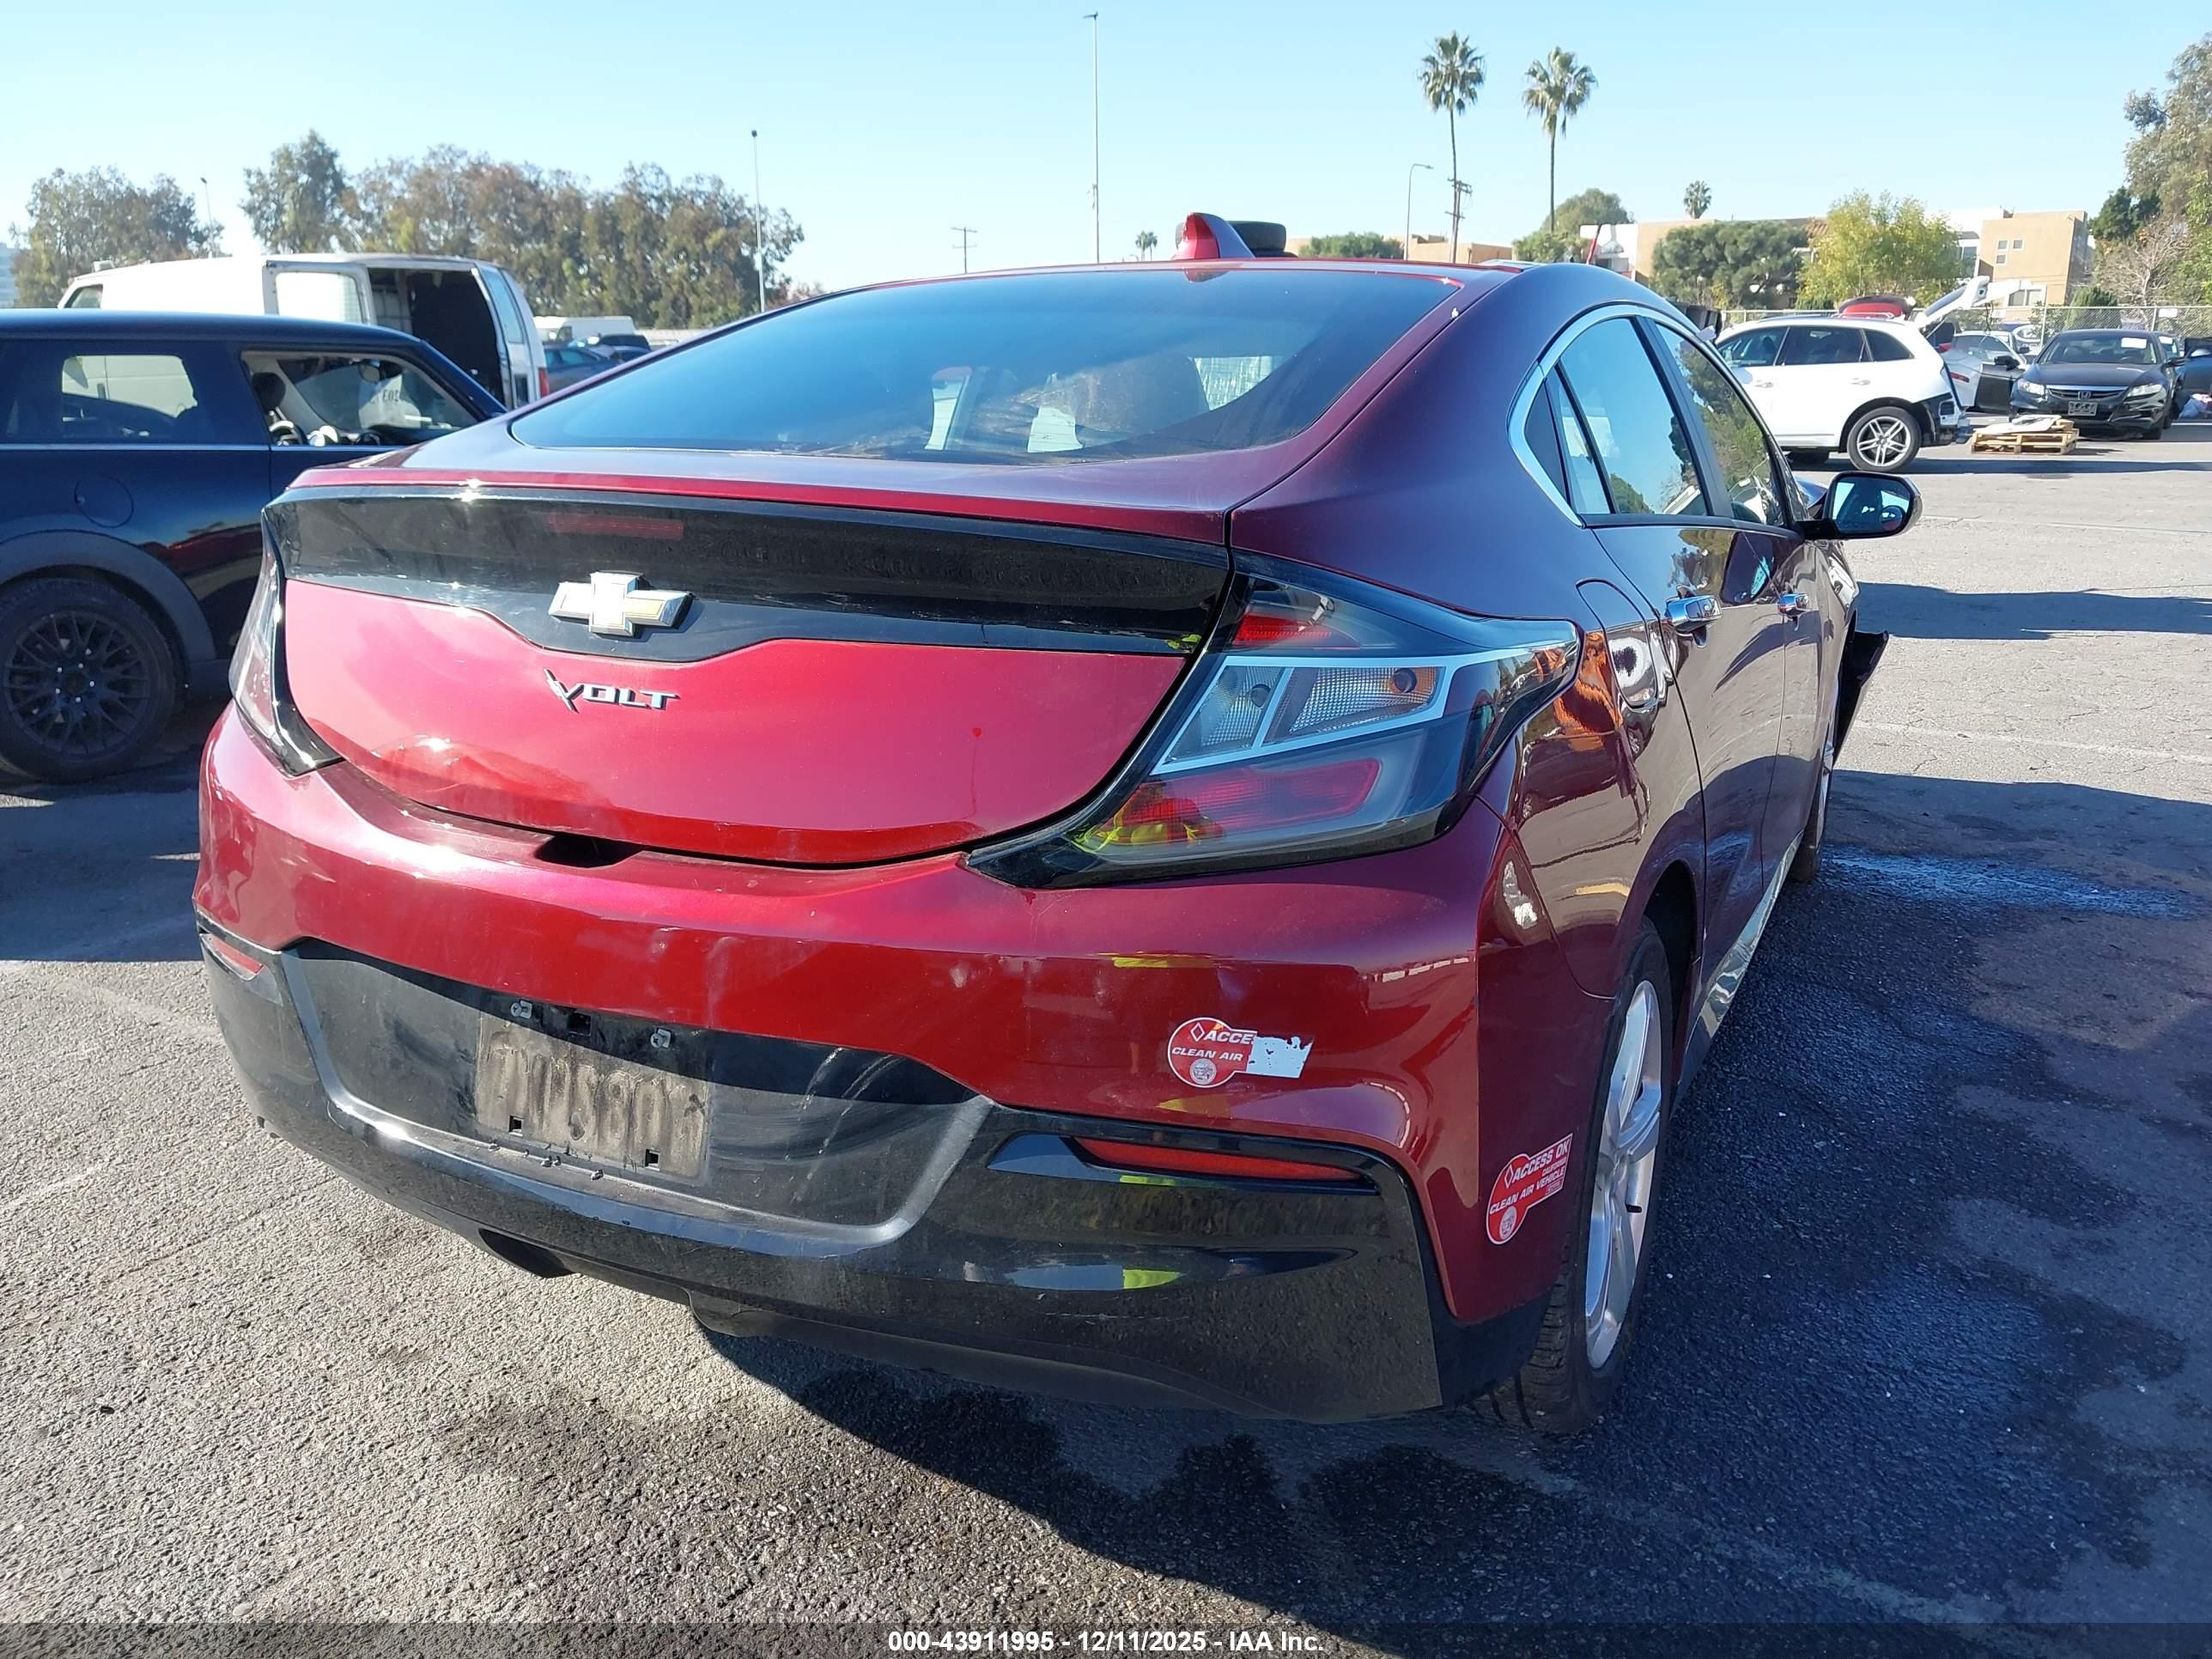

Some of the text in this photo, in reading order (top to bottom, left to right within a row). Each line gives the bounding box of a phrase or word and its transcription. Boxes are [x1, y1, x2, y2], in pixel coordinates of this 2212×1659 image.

[543, 668, 680, 714] VOLT
[1171, 1047, 1244, 1061] CLEAN AIR
[1511, 1139, 1571, 1183] ACCESS OK
[1489, 1191, 1519, 1215] CLEAN
[1519, 1184, 1535, 1200] AIR
[1536, 1167, 1565, 1190] VEHICLE
